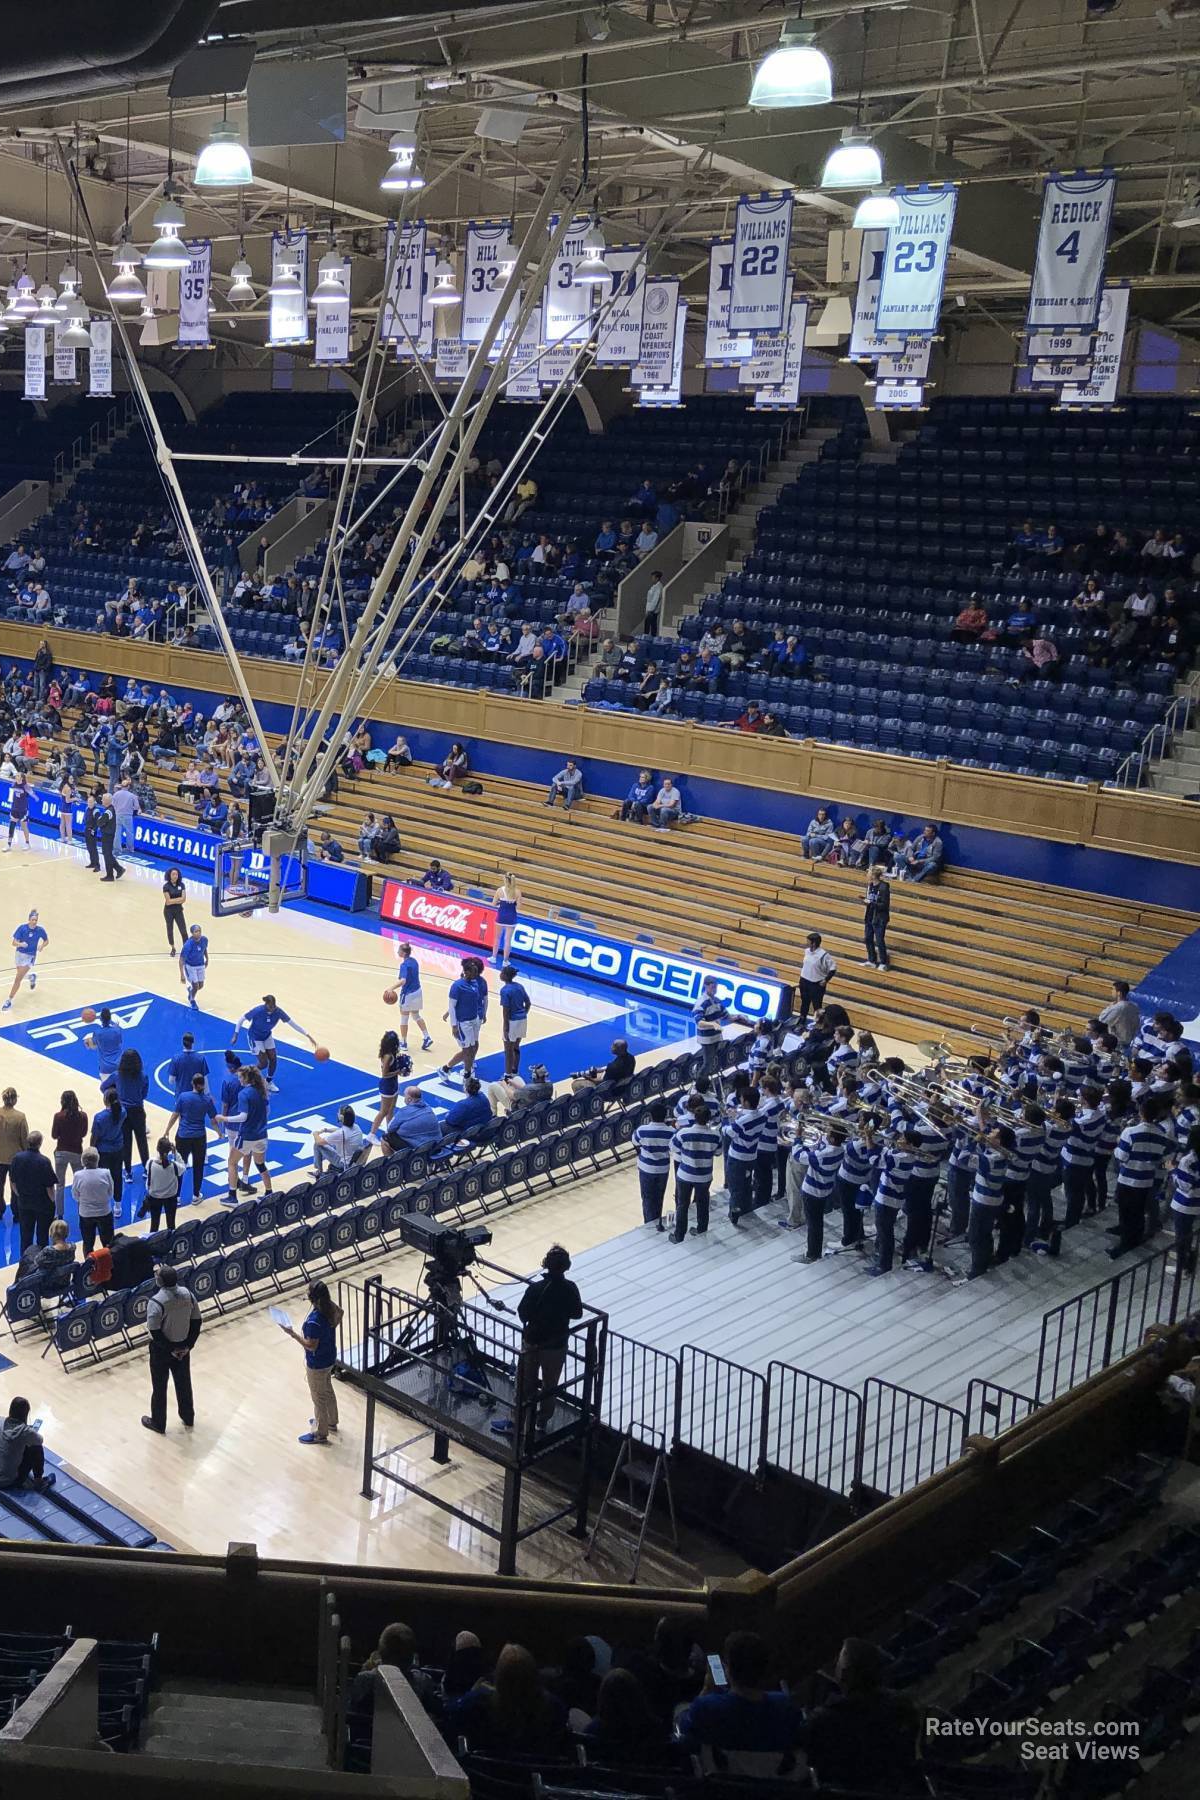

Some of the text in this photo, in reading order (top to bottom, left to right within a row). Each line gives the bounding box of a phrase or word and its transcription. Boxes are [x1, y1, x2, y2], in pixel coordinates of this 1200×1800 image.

[1051, 201, 1103, 224] REDICK
[741, 220, 786, 240] WILLIAMS
[476, 245, 498, 261] HILL
[893, 240, 938, 273] 23
[1055, 230, 1081, 263] 4
[740, 245, 780, 276] 22
[395, 265, 412, 290] 11
[184, 278, 205, 301] 35
[611, 310, 630, 318] NCAA
[620, 323, 640, 332] FOUR
[720, 343, 738, 351] 1992
[1048, 338, 1073, 348] 1999
[751, 370, 770, 379] 1978
[893, 364, 913, 372] 1979
[1049, 366, 1073, 375] 1980
[888, 389, 908, 398] 2005
[135, 825, 216, 861] BASKETBALL
[408, 896, 473, 934] Coca-Cola
[511, 923, 622, 976] GEICO
